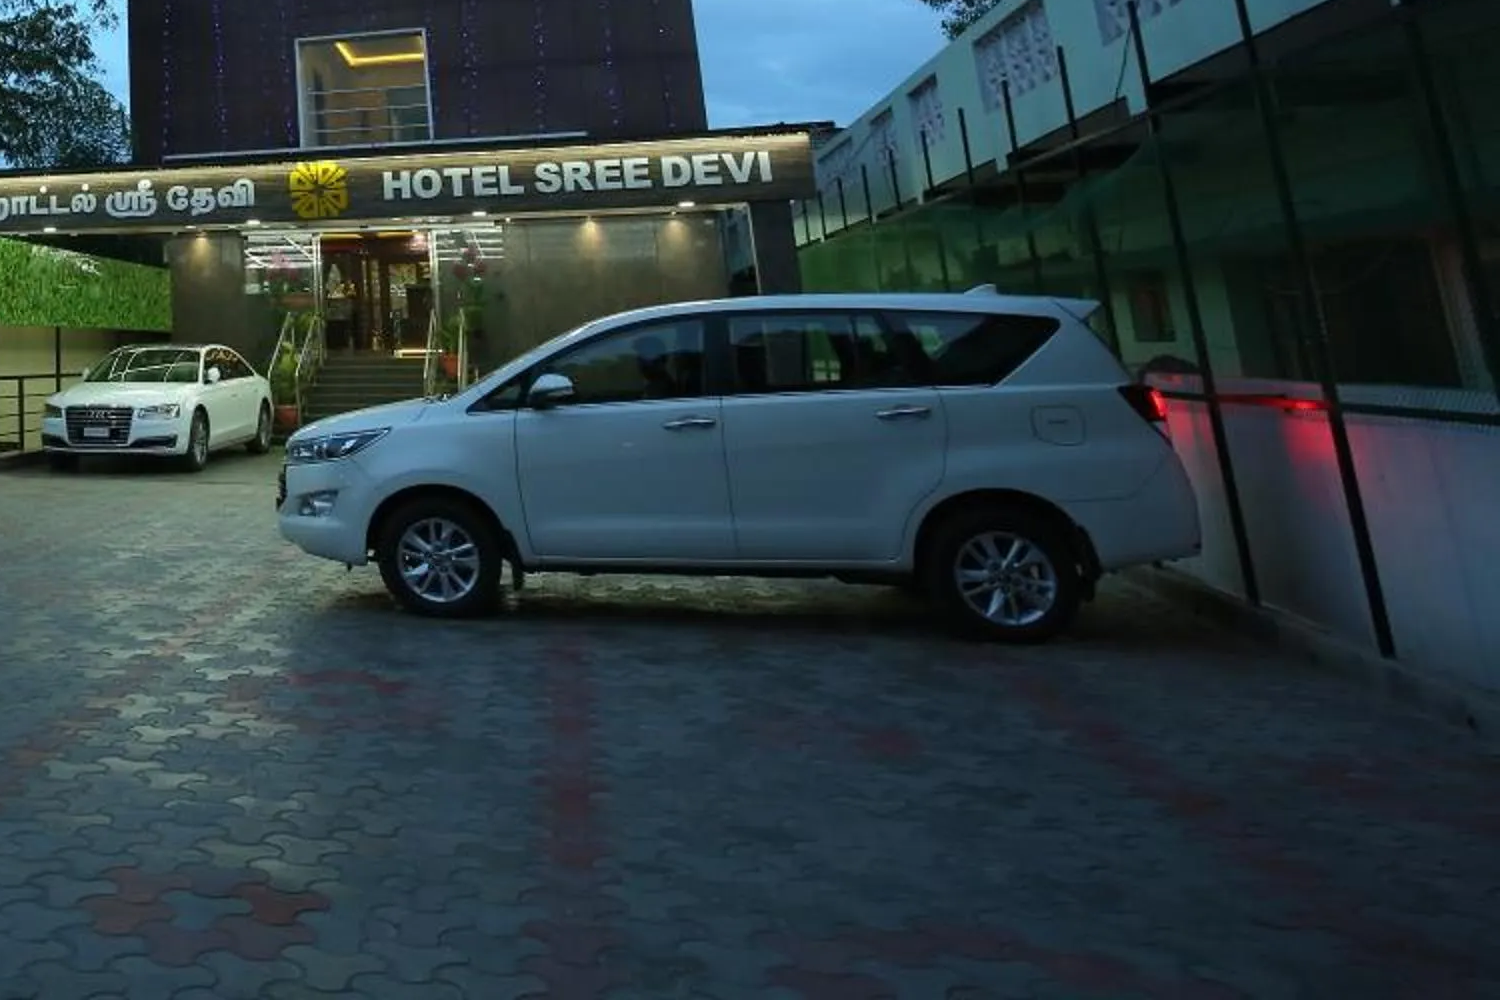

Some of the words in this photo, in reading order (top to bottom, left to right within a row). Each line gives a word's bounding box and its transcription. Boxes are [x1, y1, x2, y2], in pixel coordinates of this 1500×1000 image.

[167, 177, 255, 217] தேவி
[383, 165, 524, 200] HOTEL
[534, 157, 652, 194] SREE
[660, 151, 774, 188] DEVI
